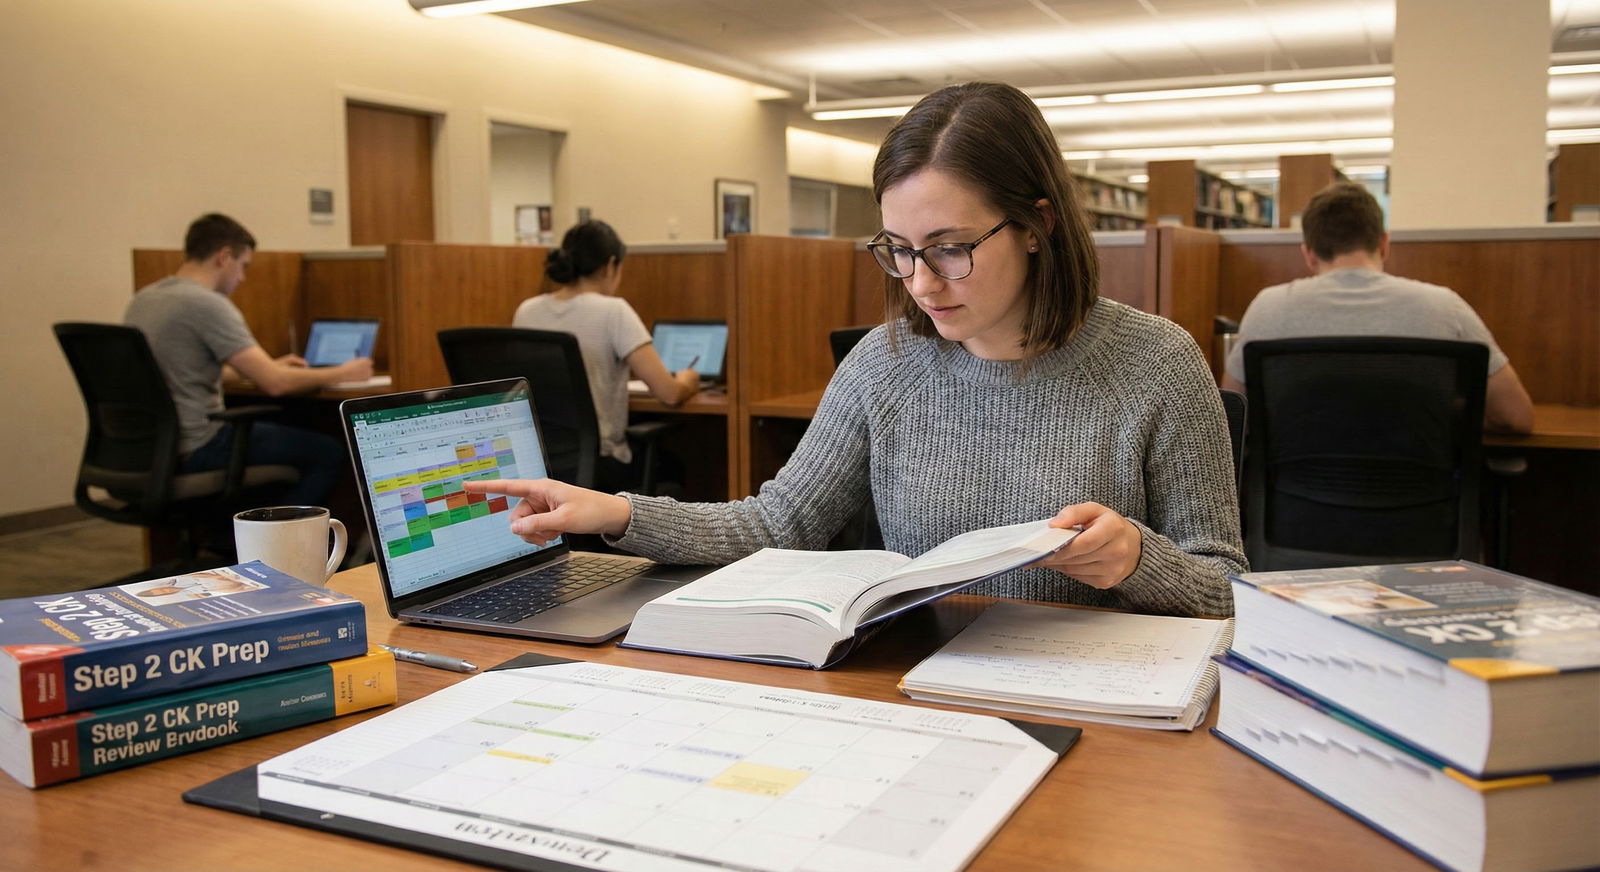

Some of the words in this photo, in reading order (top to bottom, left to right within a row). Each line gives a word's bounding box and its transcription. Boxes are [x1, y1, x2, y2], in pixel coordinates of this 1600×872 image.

[34, 596, 87, 614] CK
[82, 617, 140, 640] Step
[74, 663, 137, 692] Step
[144, 655, 162, 679] 2
[169, 646, 206, 674] CK
[212, 640, 270, 667] Prep
[91, 720, 139, 744] Step
[144, 714, 157, 733] 2
[163, 706, 190, 728] CK
[196, 699, 240, 721] Prep
[94, 738, 161, 766] Review
